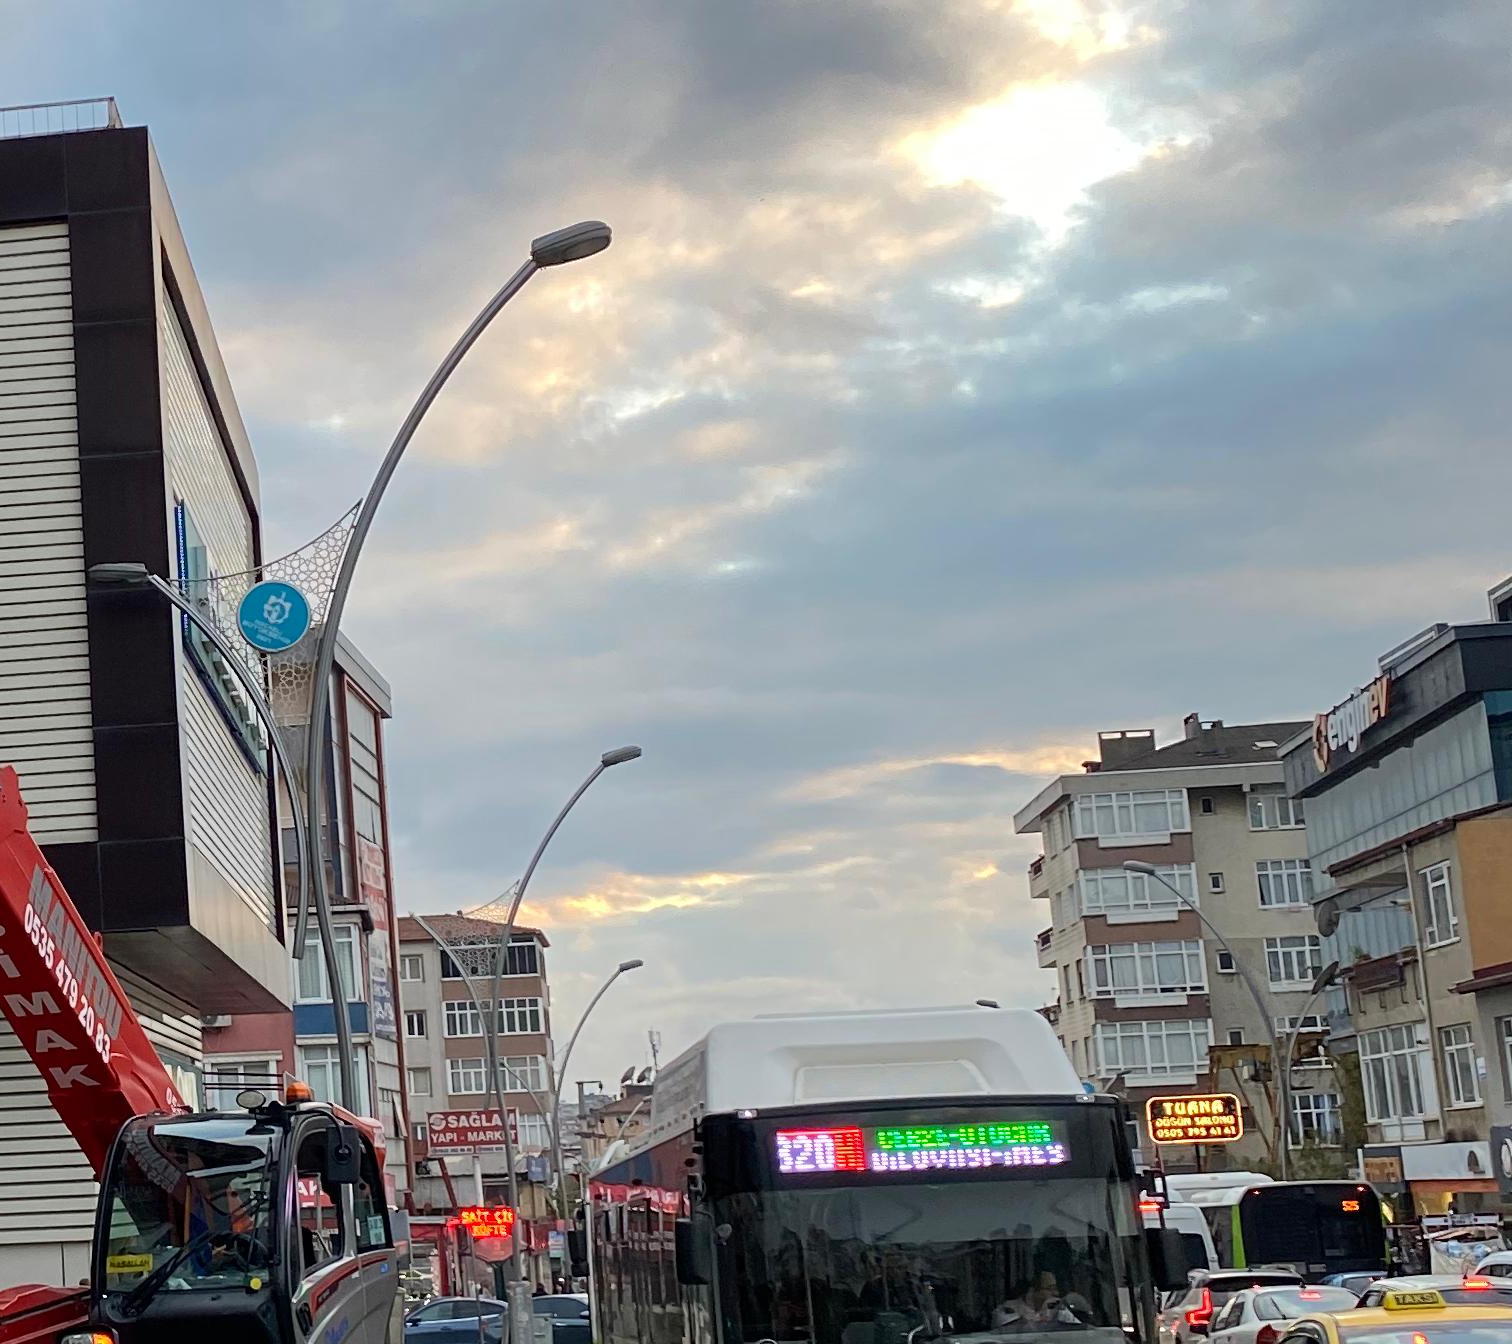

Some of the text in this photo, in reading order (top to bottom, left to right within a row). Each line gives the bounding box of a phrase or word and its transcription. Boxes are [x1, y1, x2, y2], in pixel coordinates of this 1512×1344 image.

[24, 904, 111, 1064] 0535 479 20 83
[1162, 1100, 1224, 1115] TUANA
[467, 1130, 516, 1142] MARKT
